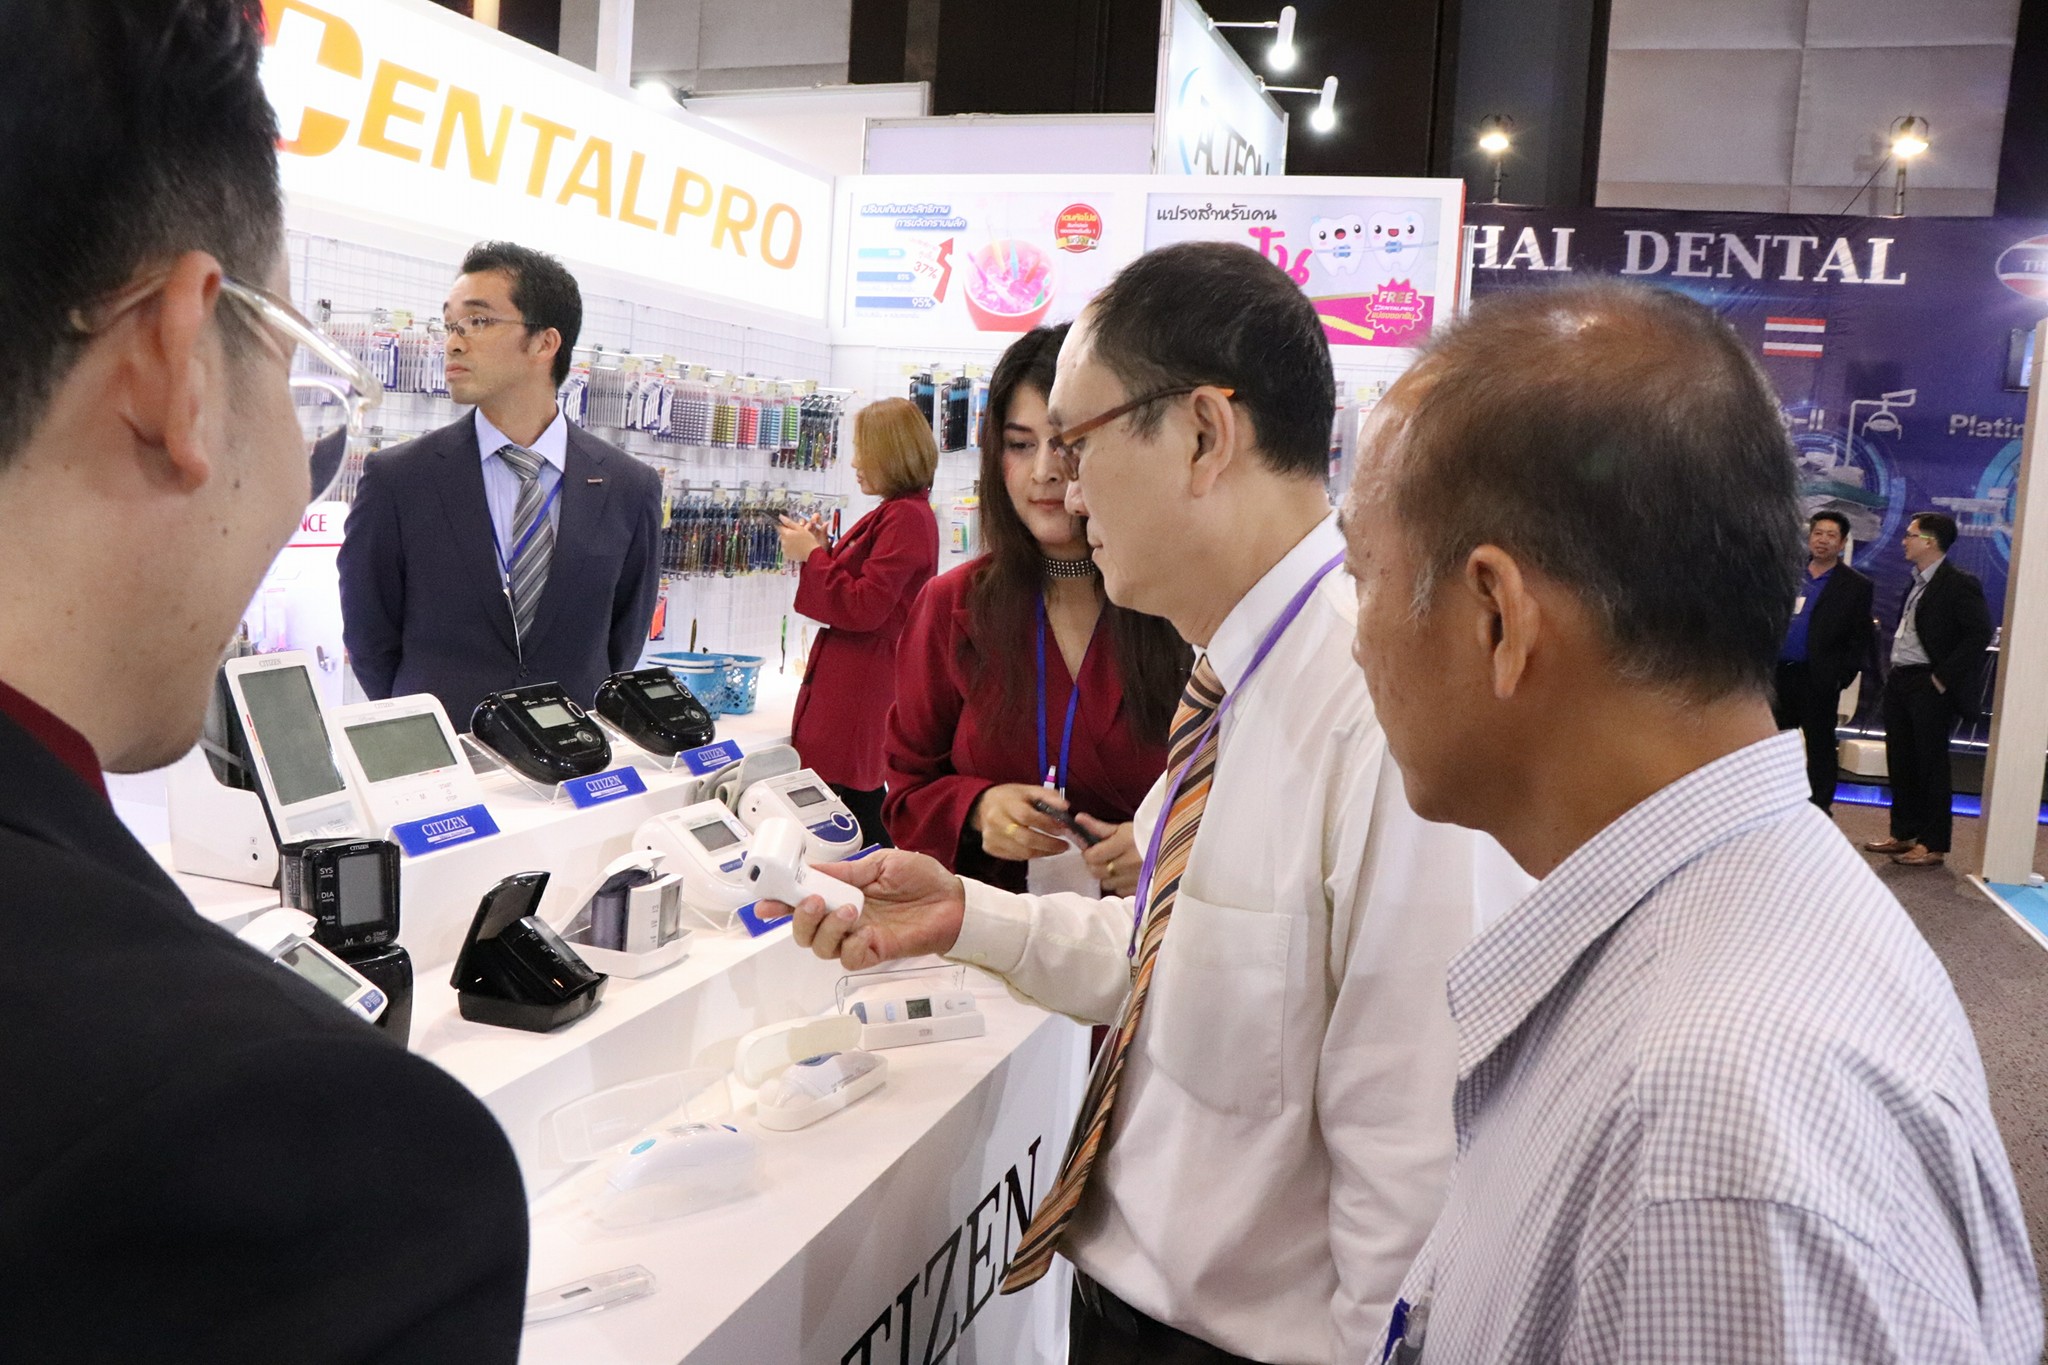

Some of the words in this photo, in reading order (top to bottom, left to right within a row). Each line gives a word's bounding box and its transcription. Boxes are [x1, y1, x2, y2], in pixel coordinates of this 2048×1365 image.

[1157, 203, 1278, 221] แปรงสำหรับคน
[1465, 226, 1576, 272] HAI
[1621, 230, 1907, 285] DENTAL
[914, 261, 939, 279] 37%
[912, 297, 932, 308] 95%
[1379, 291, 1414, 304] FREE
[698, 746, 727, 761] CITIZEN
[585, 774, 622, 792] CITIZEN
[421, 815, 469, 837] CITIZEN
[349, 843, 370, 851] CITIZEN
[320, 867, 334, 875] SYS
